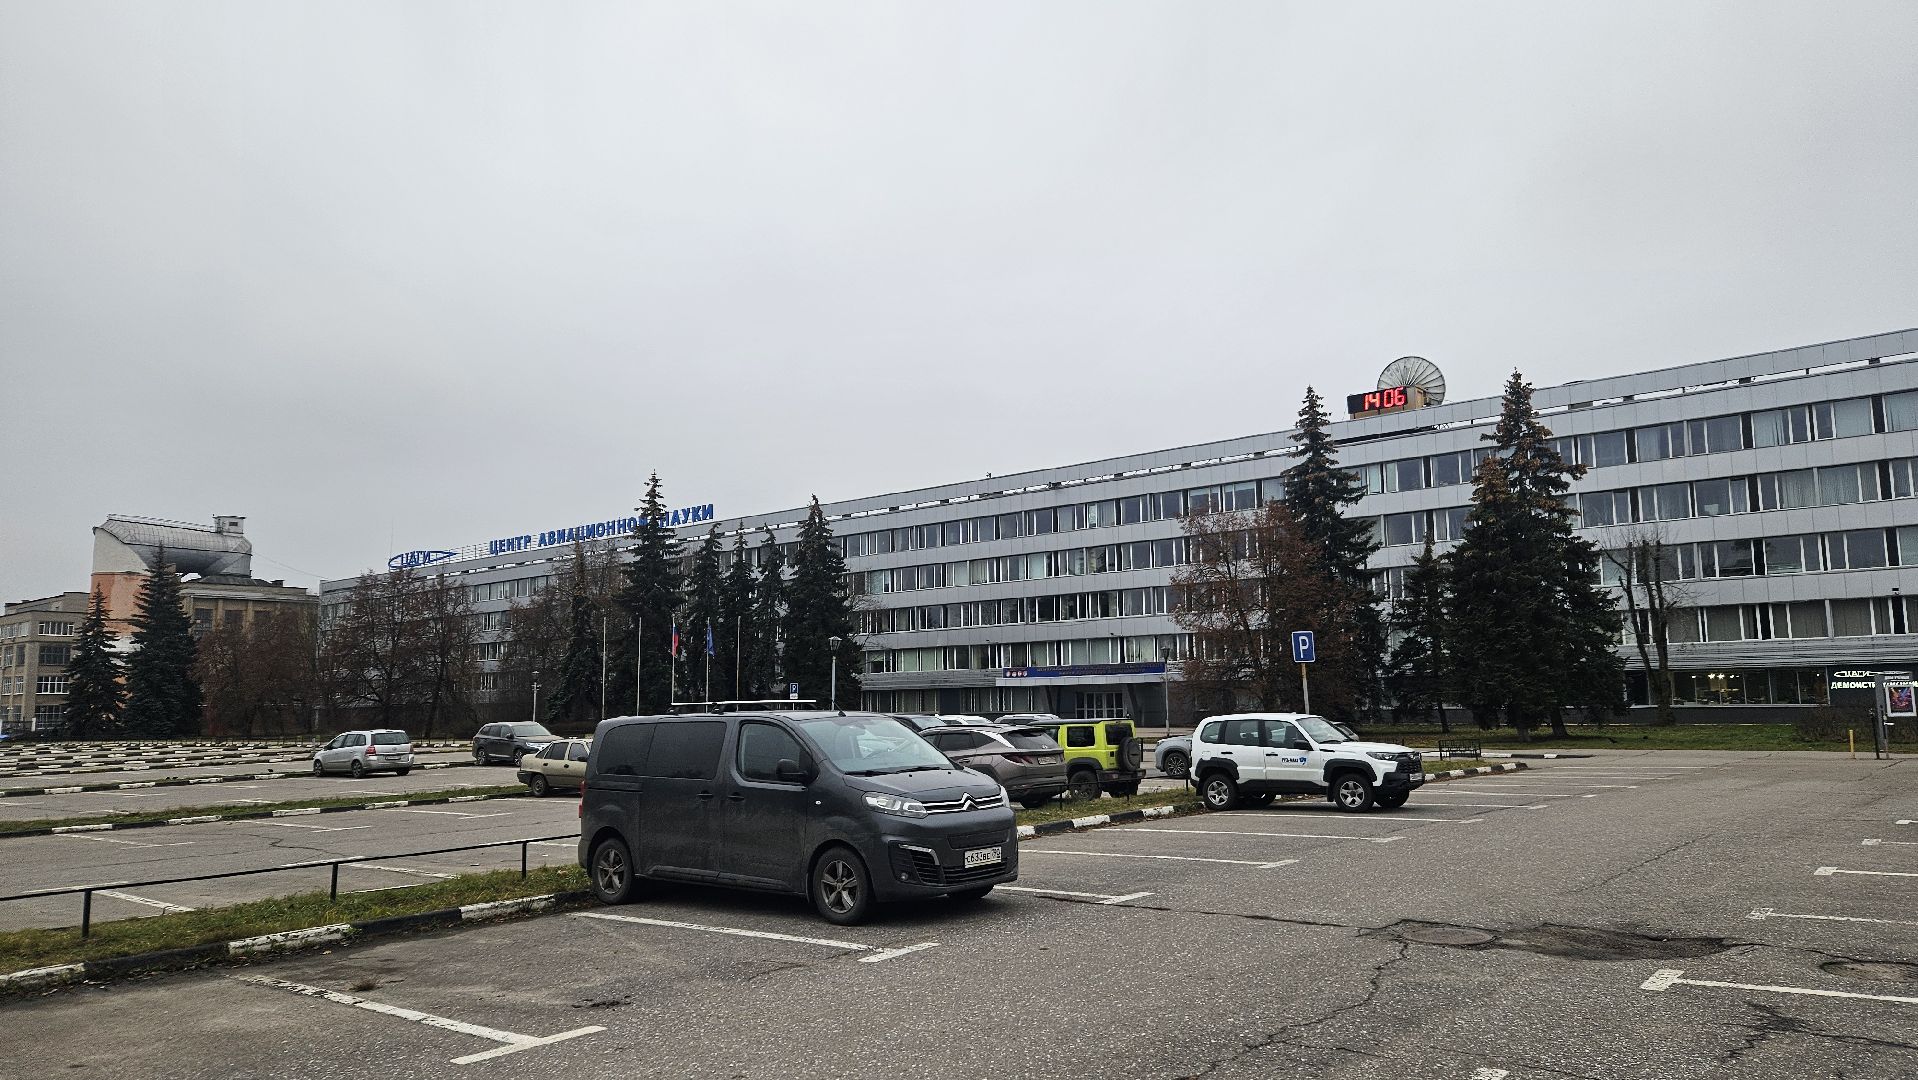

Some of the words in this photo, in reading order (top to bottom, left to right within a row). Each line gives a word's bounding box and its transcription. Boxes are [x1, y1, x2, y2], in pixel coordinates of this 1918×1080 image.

[489, 535, 532, 555] ЦЕНТР
[660, 504, 714, 528] НАУКИ
[400, 551, 430, 566] ЦАГИ
[1299, 636, 1309, 658] P
